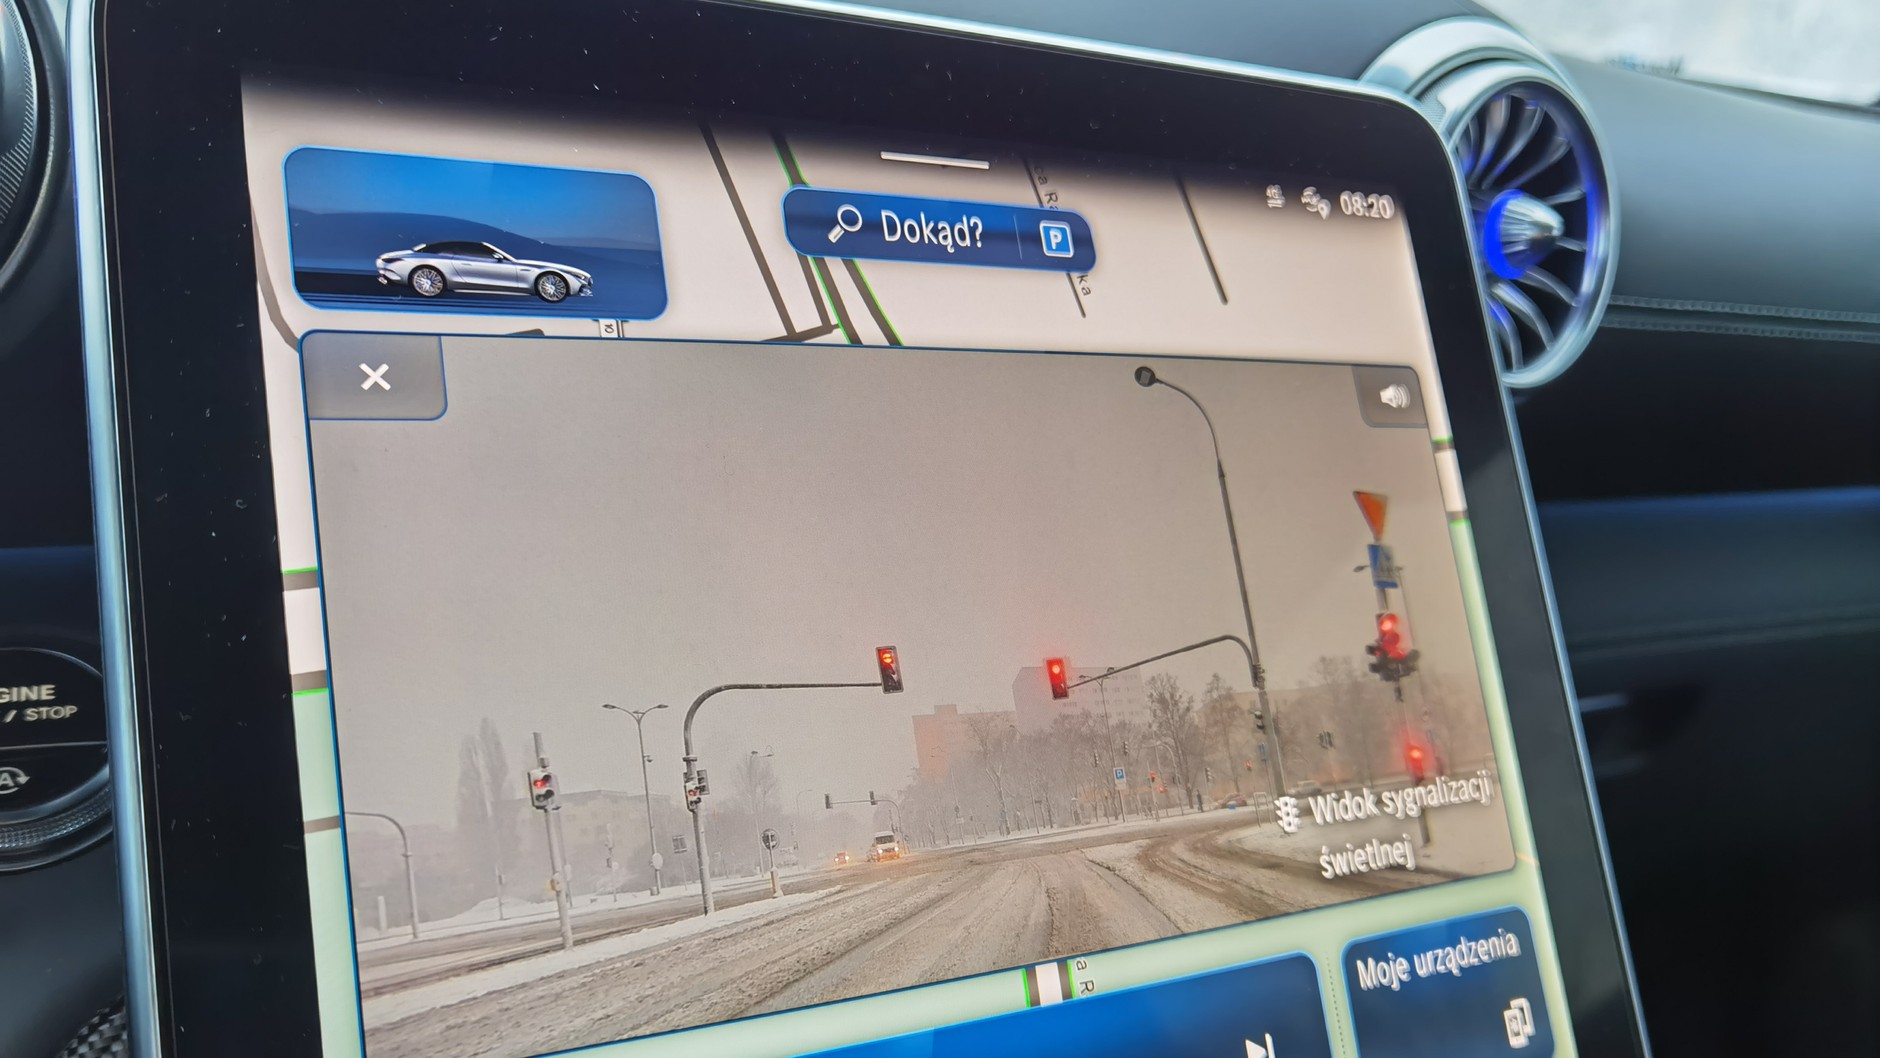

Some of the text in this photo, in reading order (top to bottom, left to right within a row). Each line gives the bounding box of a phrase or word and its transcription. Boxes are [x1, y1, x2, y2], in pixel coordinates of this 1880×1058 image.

[1340, 190, 1395, 220] 08:20
[881, 209, 983, 254] Dokąd?
[24, 705, 78, 721] STOP
[1309, 769, 1495, 826] Widok sygnalizacji
[1319, 833, 1416, 880] świetlnej
[1356, 928, 1522, 992] Moje urządzenia
